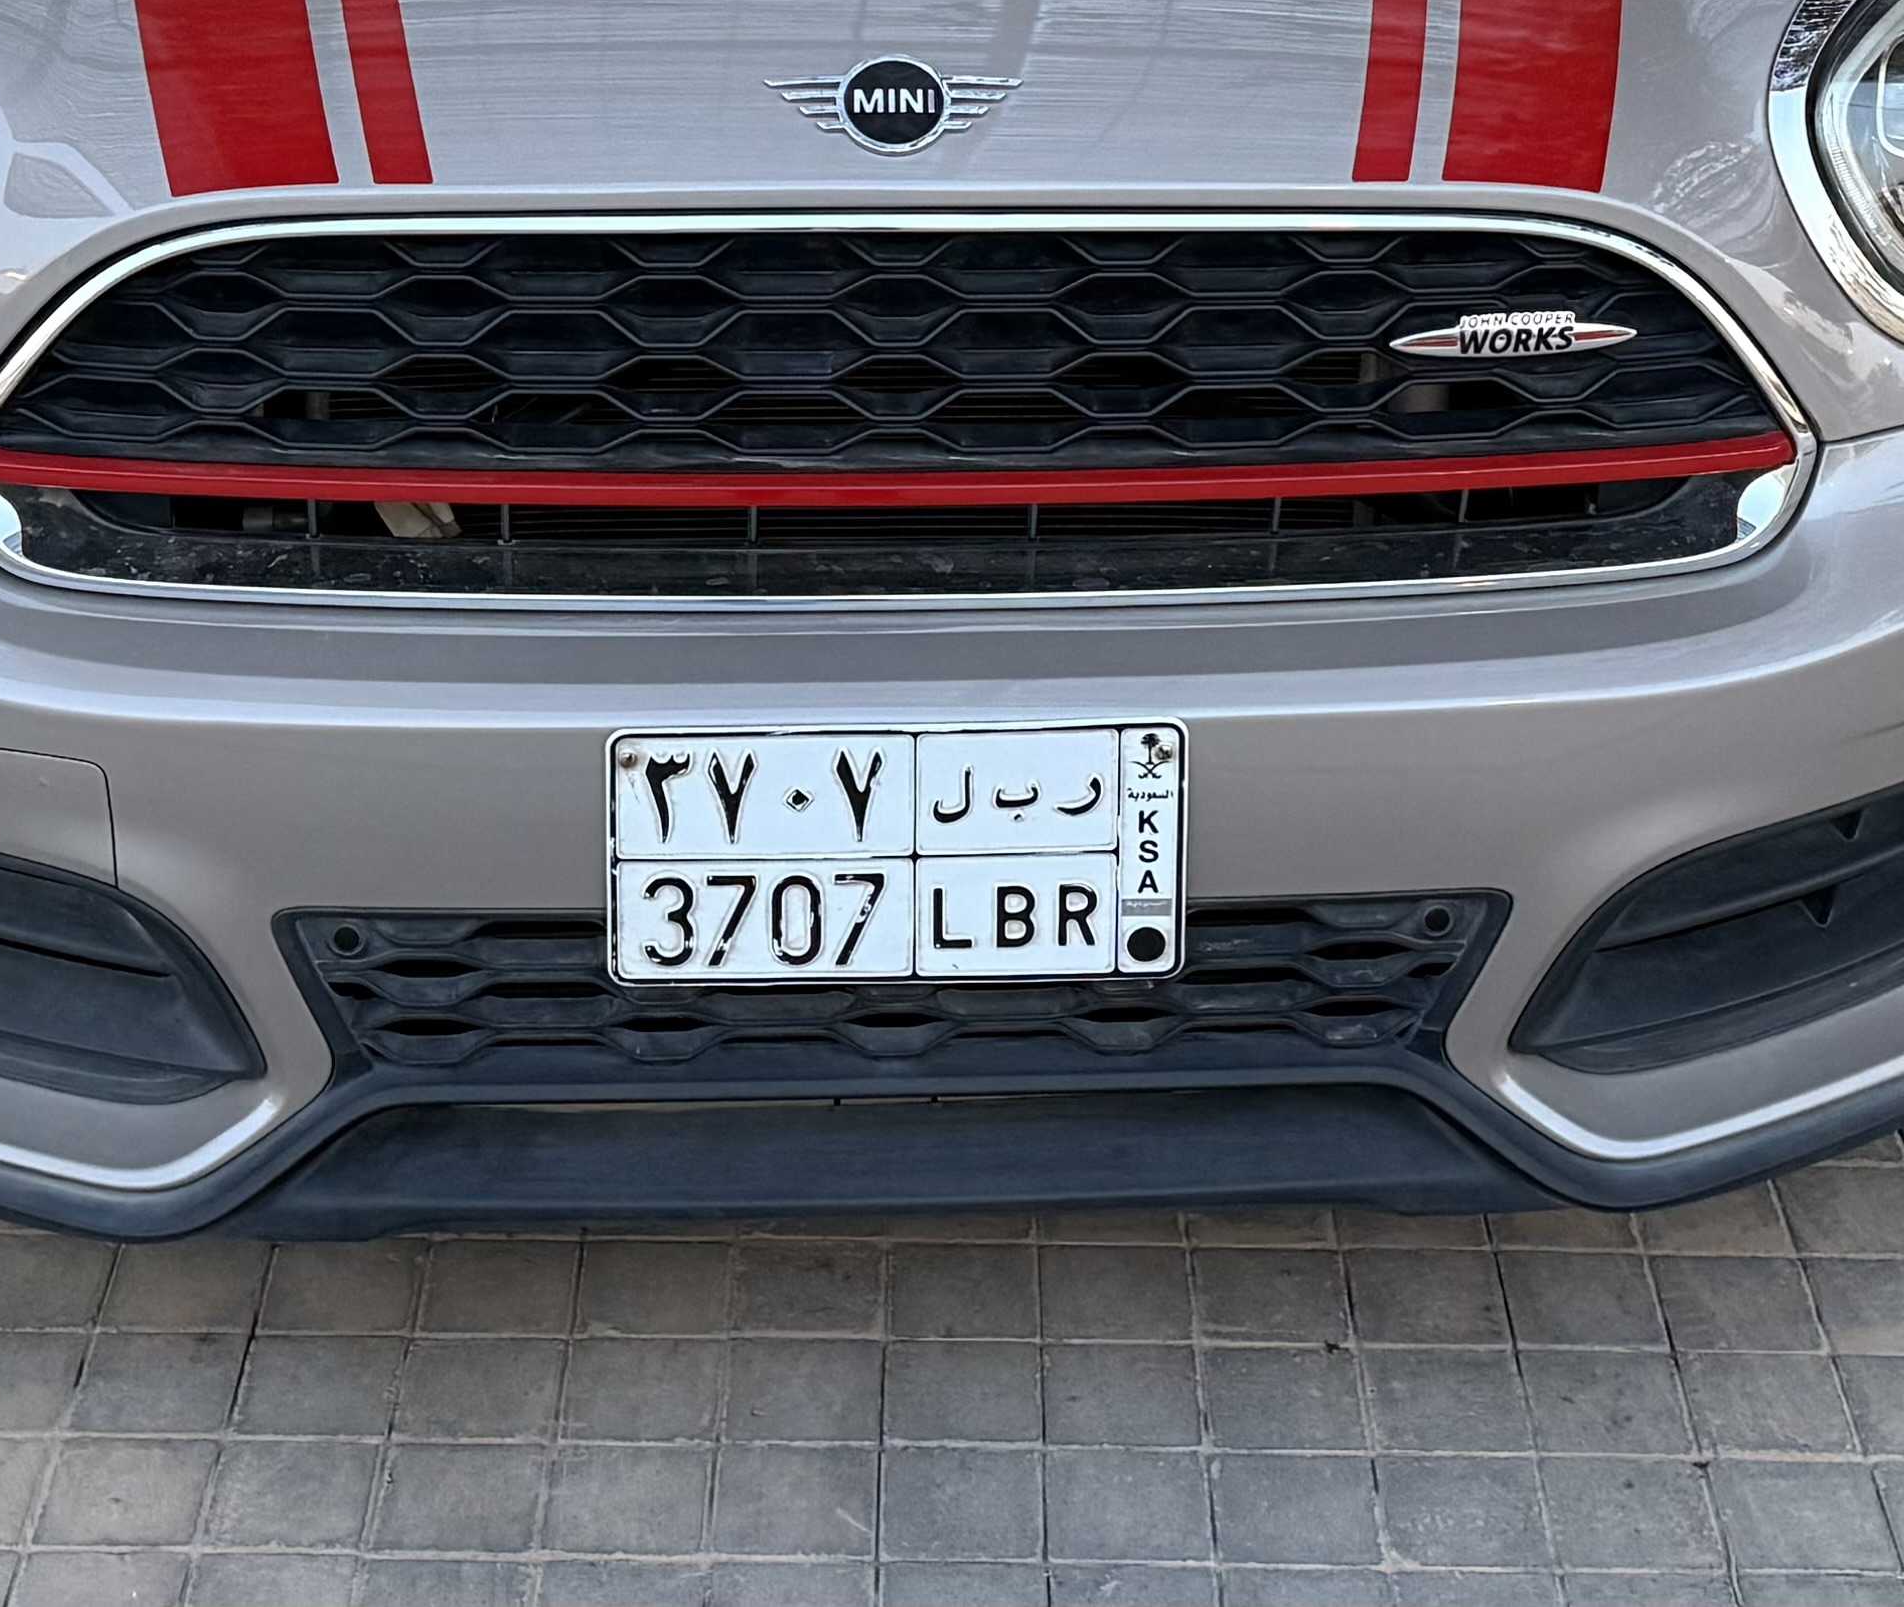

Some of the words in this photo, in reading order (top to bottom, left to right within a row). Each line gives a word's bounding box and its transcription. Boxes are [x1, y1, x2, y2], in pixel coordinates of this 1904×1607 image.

[853, 88, 936, 114] MINI
[1460, 315, 1504, 329] JOHN
[1511, 312, 1574, 326] COOPER
[1459, 325, 1575, 354] WORKS
[643, 749, 885, 844] ٣٧٠٧
[1127, 787, 1174, 803] السعودية
[642, 873, 885, 968] 3707
[931, 882, 1098, 950] LBR
